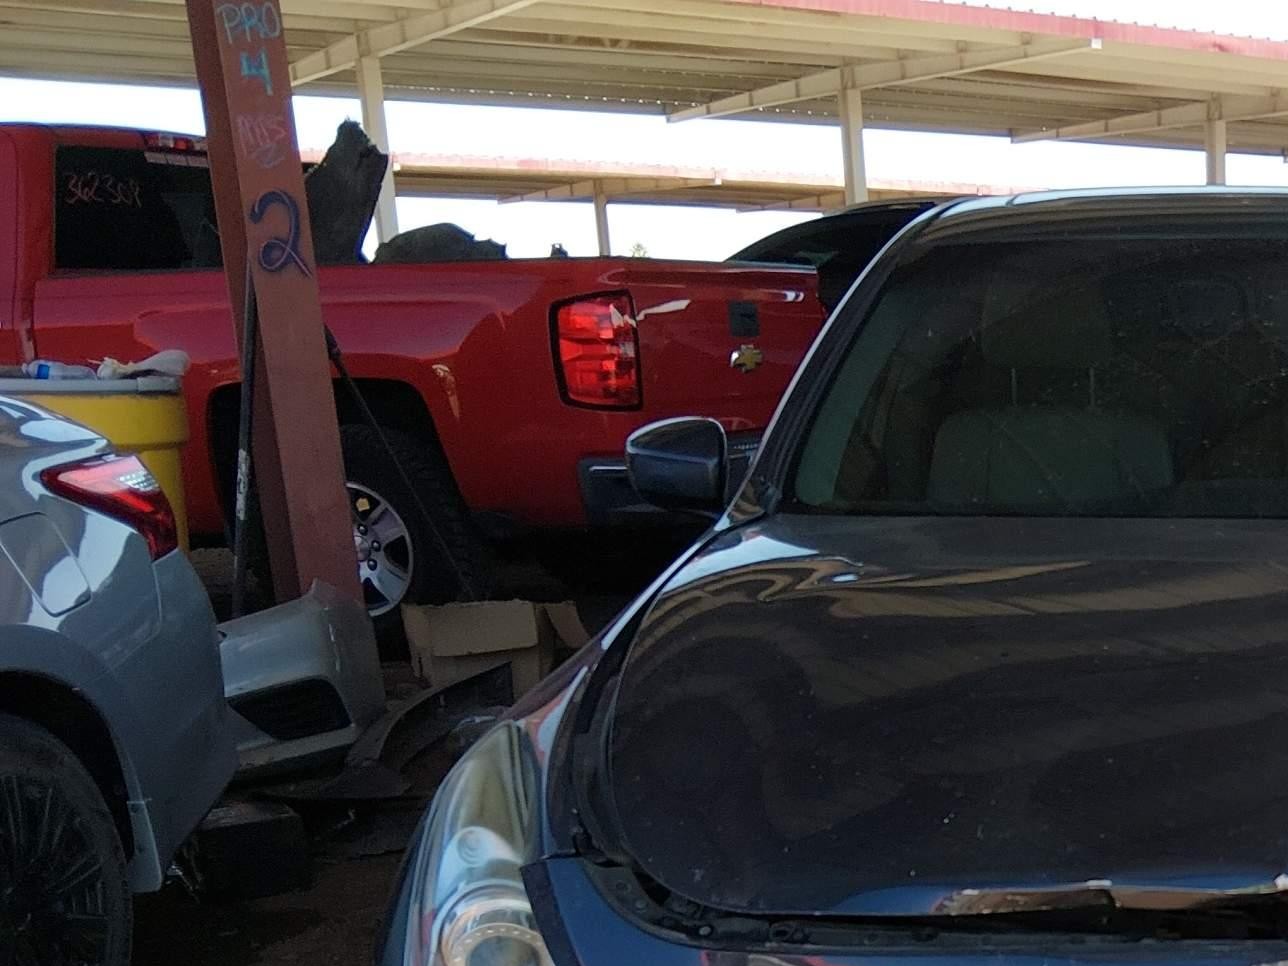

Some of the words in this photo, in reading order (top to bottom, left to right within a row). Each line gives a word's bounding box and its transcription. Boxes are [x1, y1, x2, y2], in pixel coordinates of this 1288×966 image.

[217, 2, 281, 44] PRO
[239, 48, 274, 95] 4
[251, 188, 312, 278] 2
